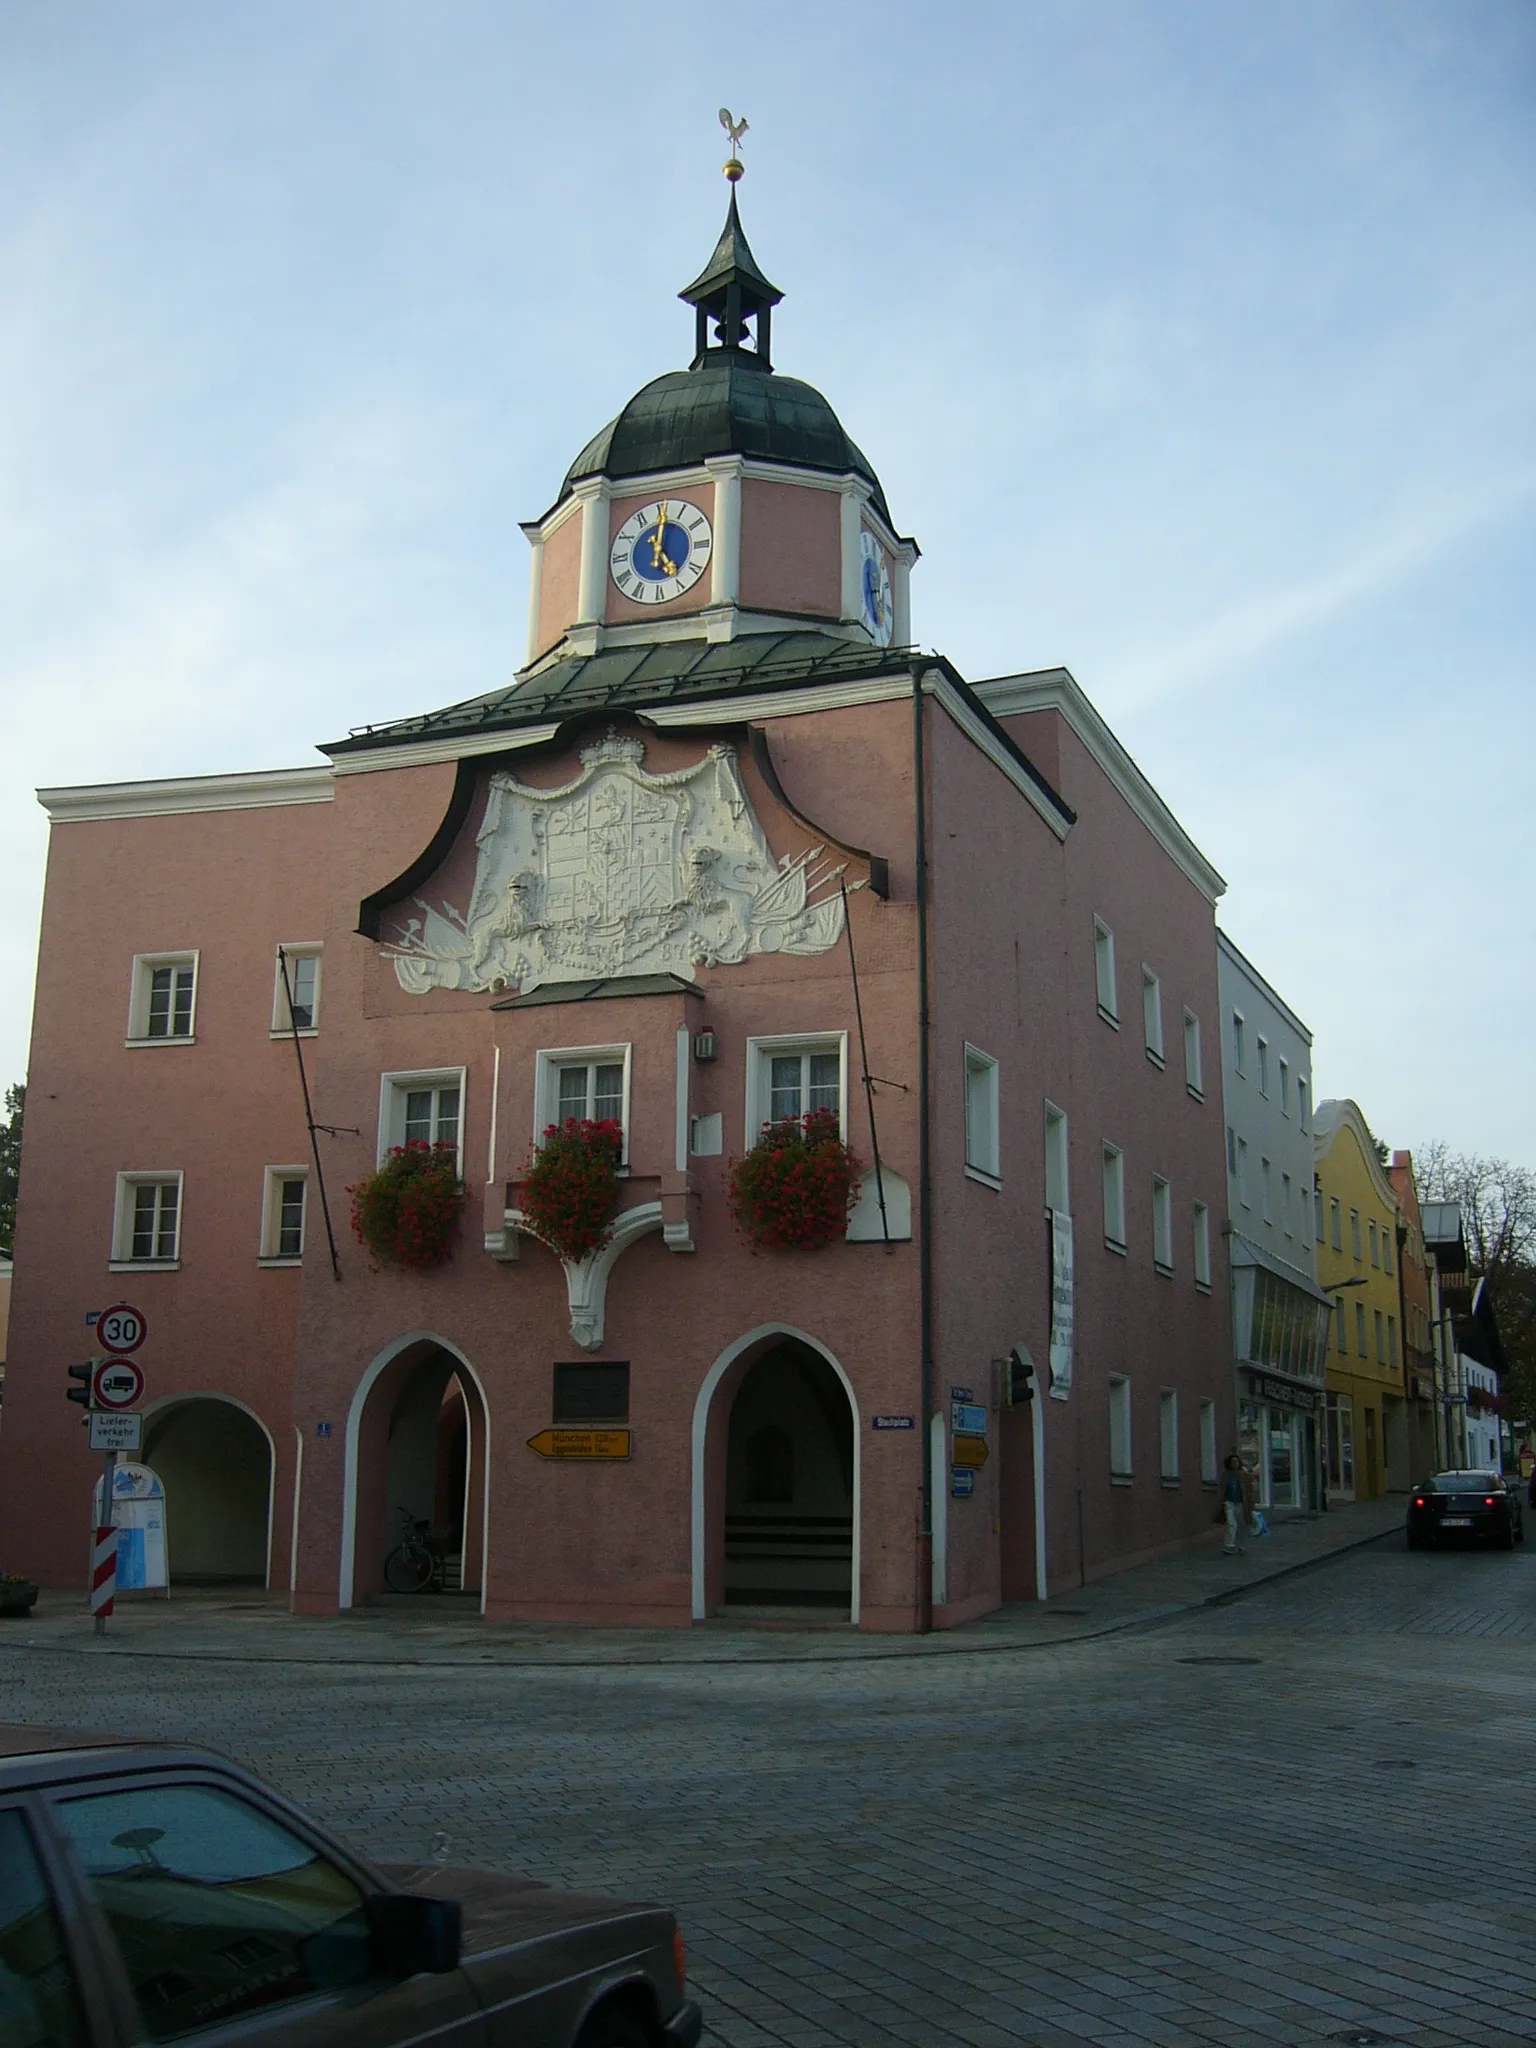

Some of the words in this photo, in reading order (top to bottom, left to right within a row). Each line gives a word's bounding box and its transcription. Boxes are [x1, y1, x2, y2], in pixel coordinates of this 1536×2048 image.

[108, 1318, 137, 1342] 30
[100, 1415, 132, 1425] Liefer-
[97, 1426, 134, 1436] verkehr
[107, 1437, 124, 1447] frei
